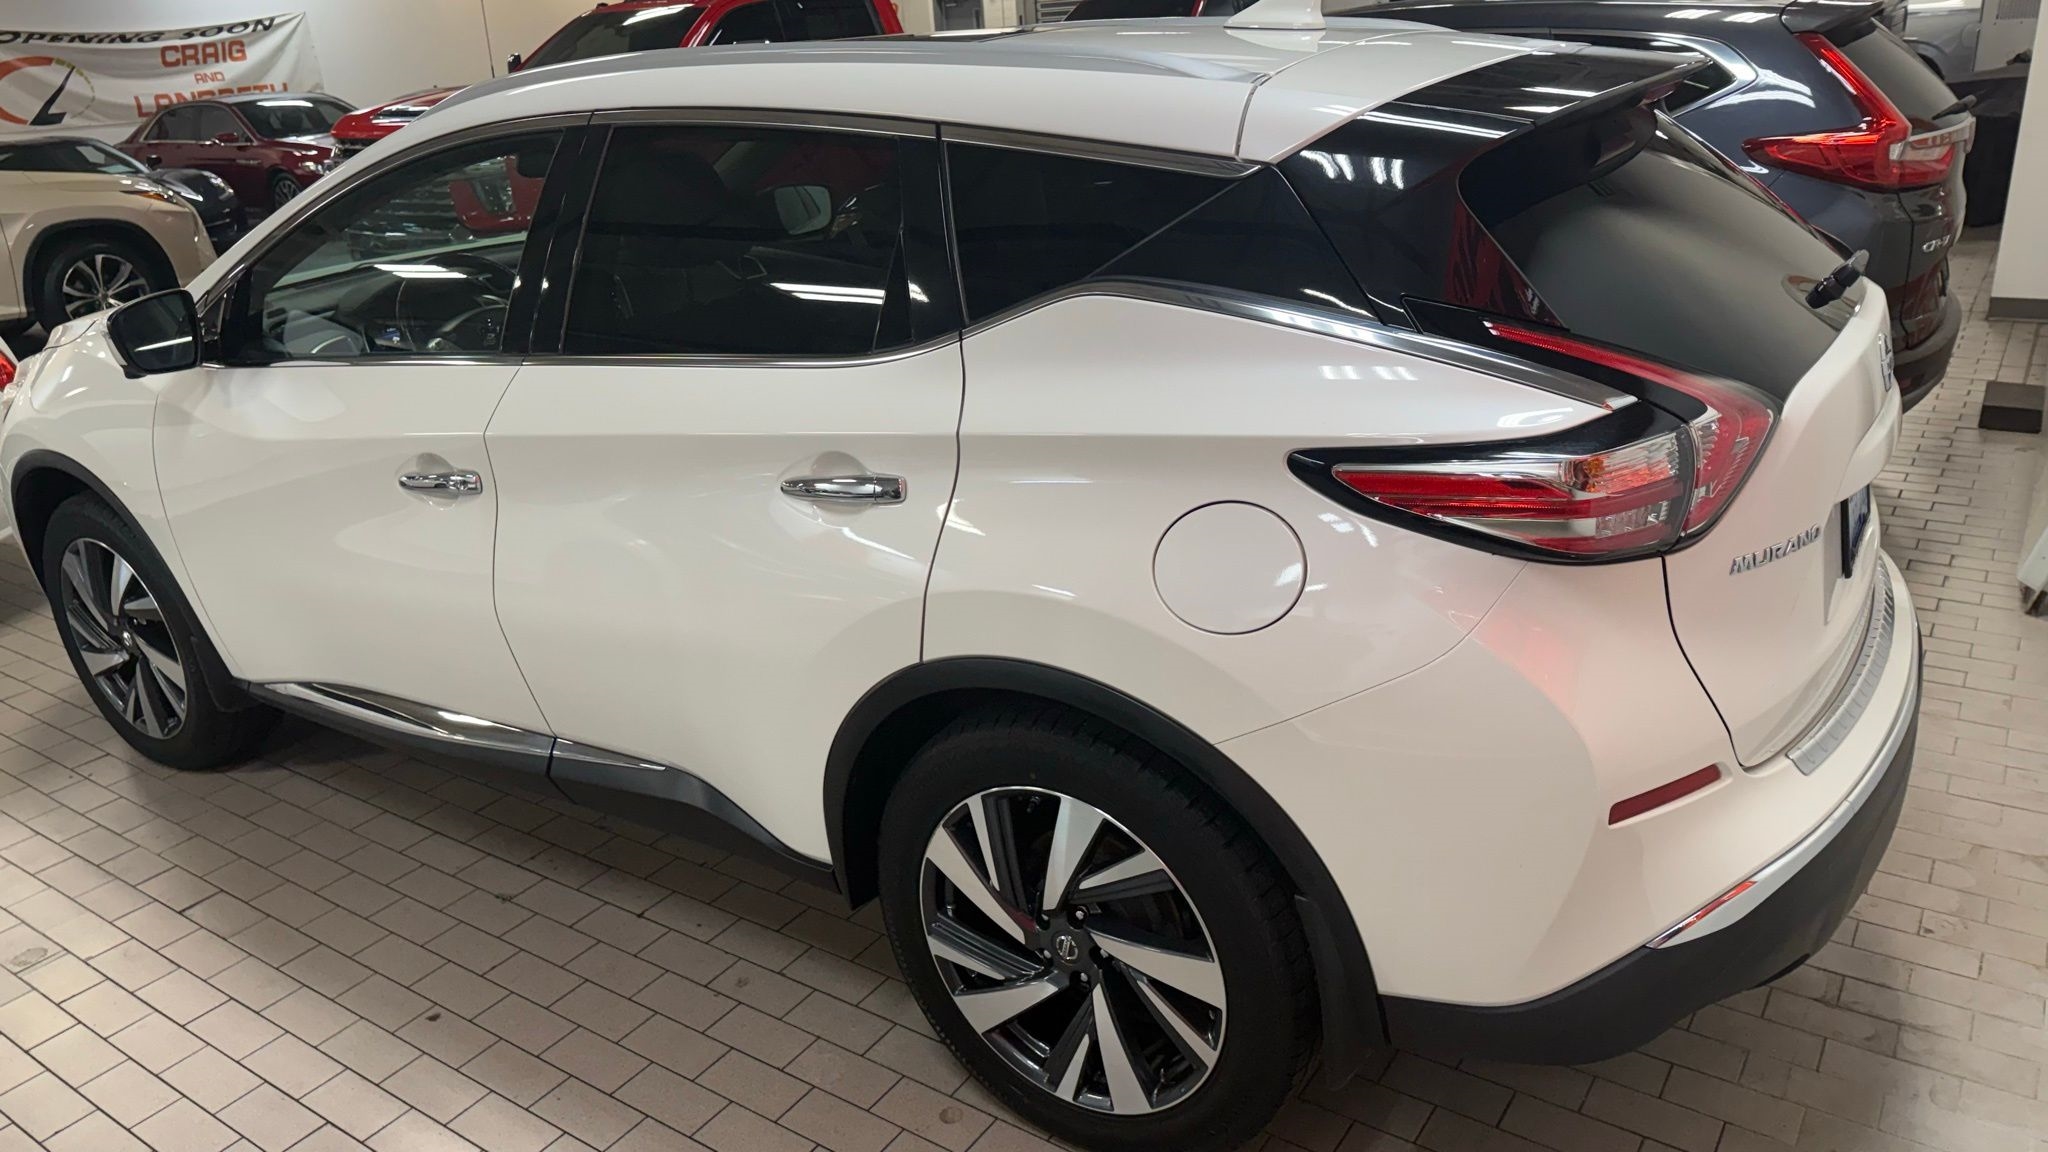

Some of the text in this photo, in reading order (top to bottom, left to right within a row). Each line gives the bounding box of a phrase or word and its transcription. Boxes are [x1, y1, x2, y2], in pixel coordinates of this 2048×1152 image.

[0, 17, 277, 44] OPENING SOON
[160, 40, 248, 68] CRAIG
[194, 71, 226, 84] AND
[1729, 524, 1821, 575] MURANO
